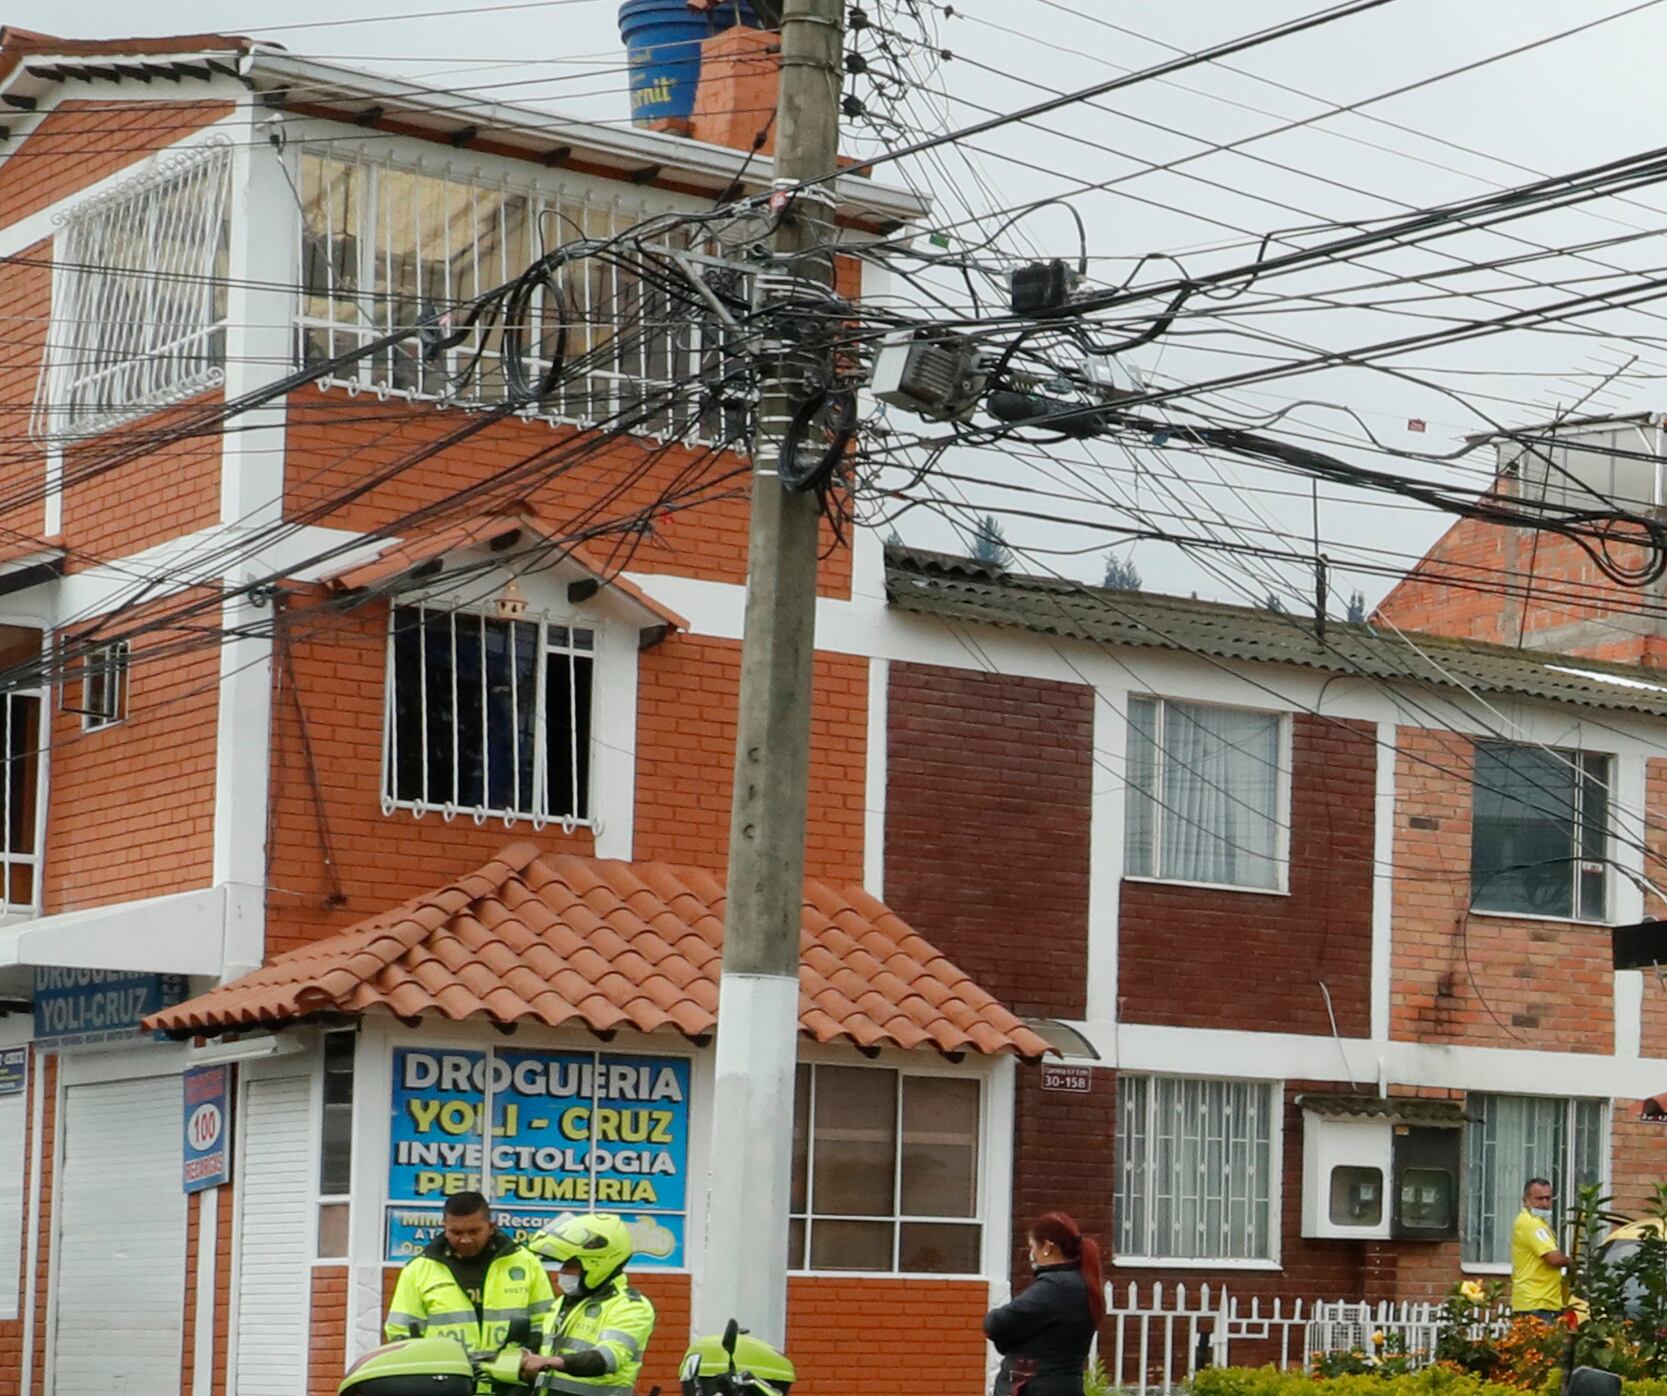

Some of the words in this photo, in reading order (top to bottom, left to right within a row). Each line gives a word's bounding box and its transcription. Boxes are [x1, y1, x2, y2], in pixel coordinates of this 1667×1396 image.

[403, 1053, 683, 1102] DROGUERIA
[194, 1111, 216, 1143] 100
[409, 1099, 519, 1137] YOLI
[561, 1107, 674, 1144] CRUZ
[397, 1141, 677, 1175] INYECTOLOGIA
